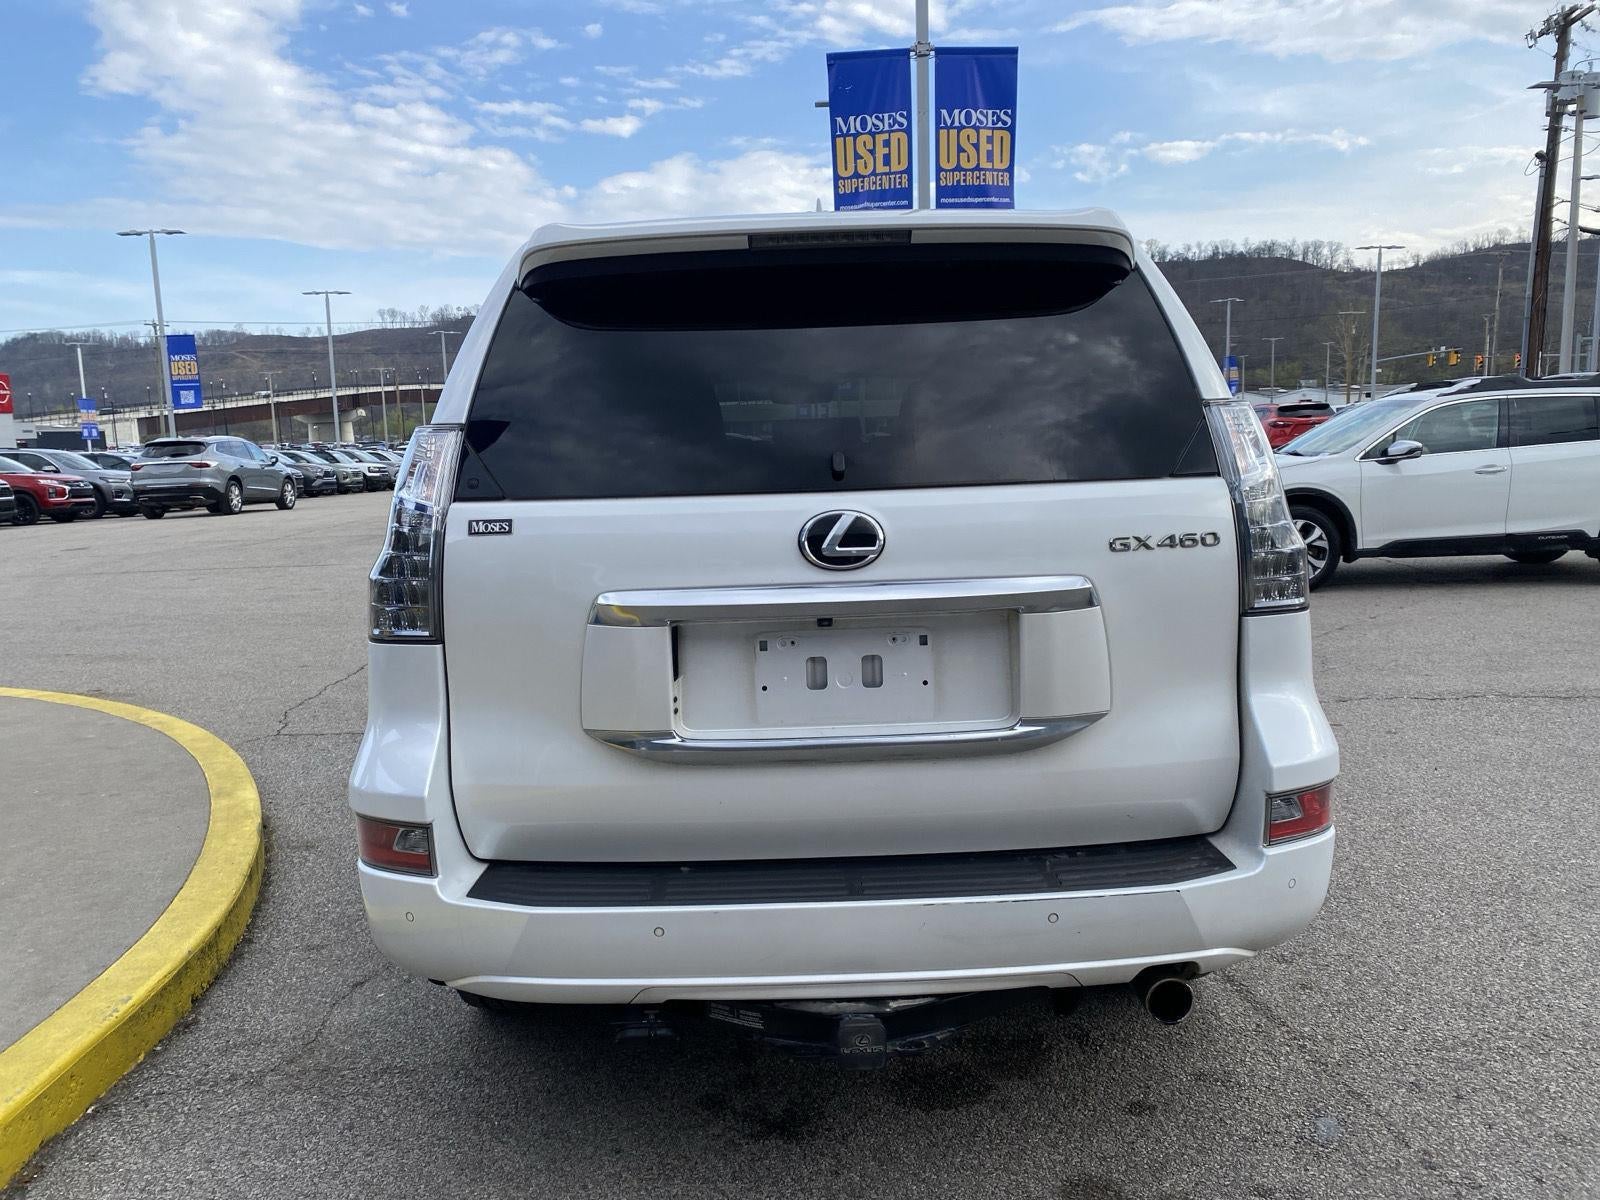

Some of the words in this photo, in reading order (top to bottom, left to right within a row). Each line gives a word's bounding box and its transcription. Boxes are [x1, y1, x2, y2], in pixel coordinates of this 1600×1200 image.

[835, 110, 908, 135] MOSES
[939, 108, 1012, 128] MOSES
[835, 131, 909, 178] USED
[938, 128, 1012, 170] USED
[838, 173, 909, 194] SUPERCENTER
[939, 171, 1010, 187] SUPERCENTER
[170, 354, 197, 362] MOSES
[171, 361, 198, 375] USED
